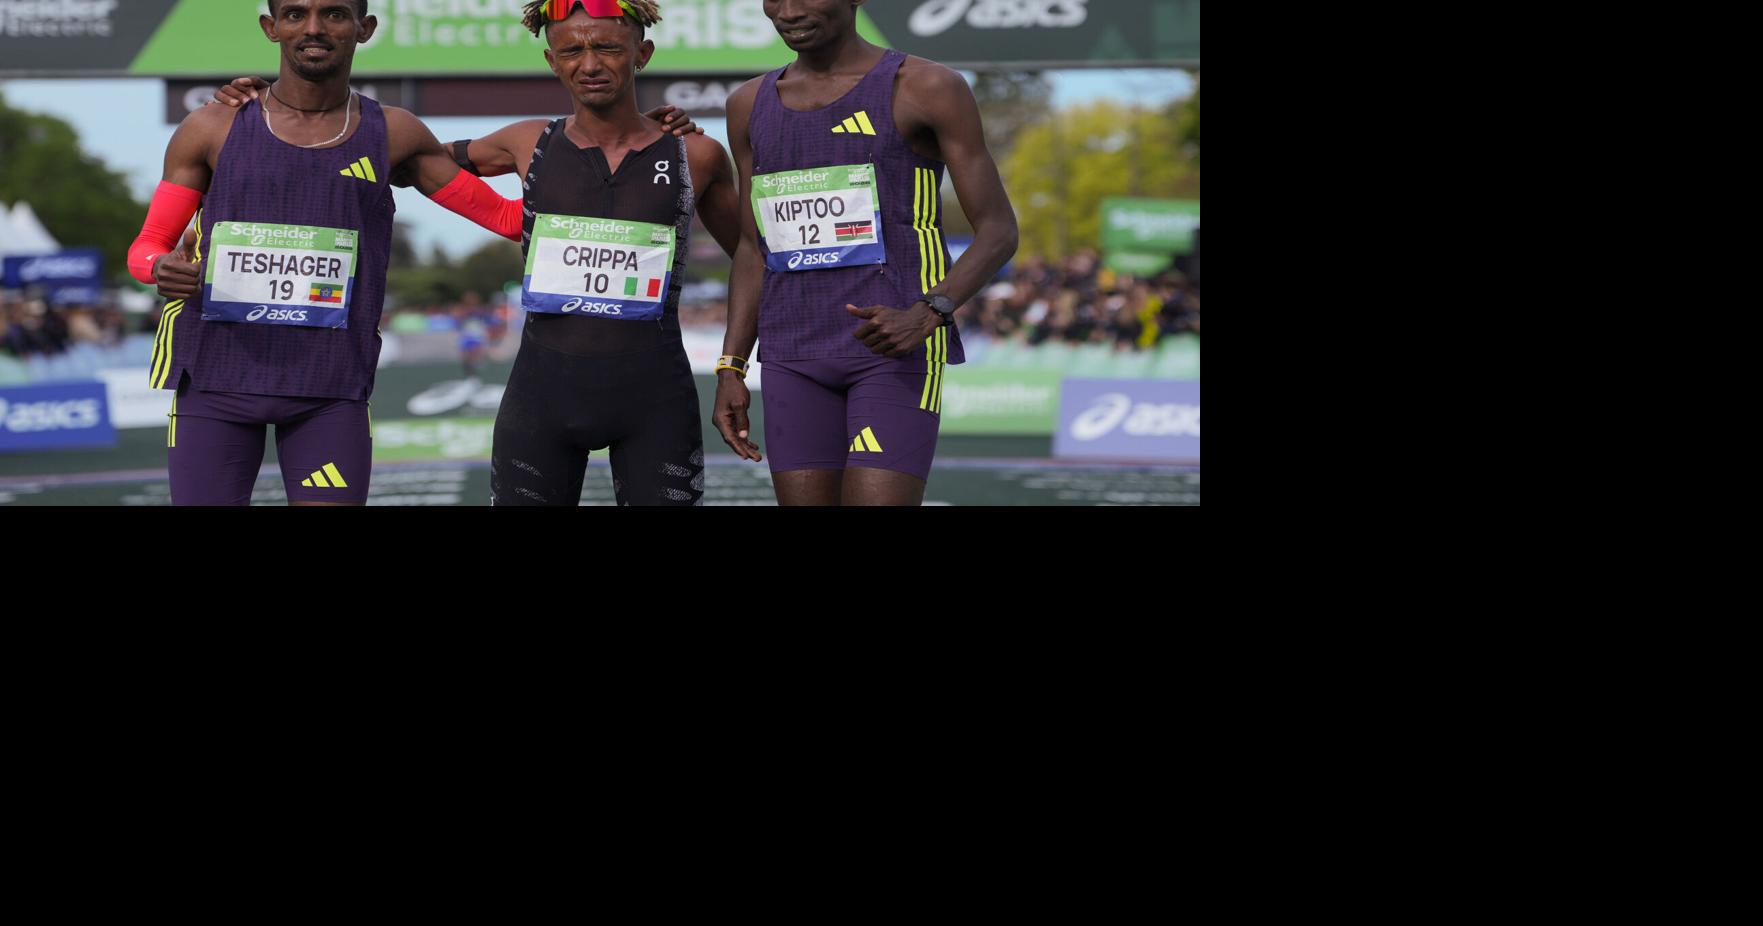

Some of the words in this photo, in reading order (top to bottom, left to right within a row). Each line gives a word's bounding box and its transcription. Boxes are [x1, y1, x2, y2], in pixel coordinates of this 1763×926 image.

[762, 171, 830, 188] Schneider
[787, 183, 829, 192] Electric
[774, 196, 845, 223] KIPTOO
[229, 222, 319, 241] Schneider
[550, 216, 634, 235] Schneider
[798, 223, 821, 246] 12
[266, 235, 315, 249] Electric
[583, 229, 630, 242] Electric
[227, 251, 342, 279] TESHAGER
[562, 245, 639, 272] CRIPPA
[802, 252, 840, 266] asics
[269, 279, 295, 301] 19
[583, 272, 610, 294] 10
[266, 308, 308, 322] asics
[580, 301, 624, 316] asics
